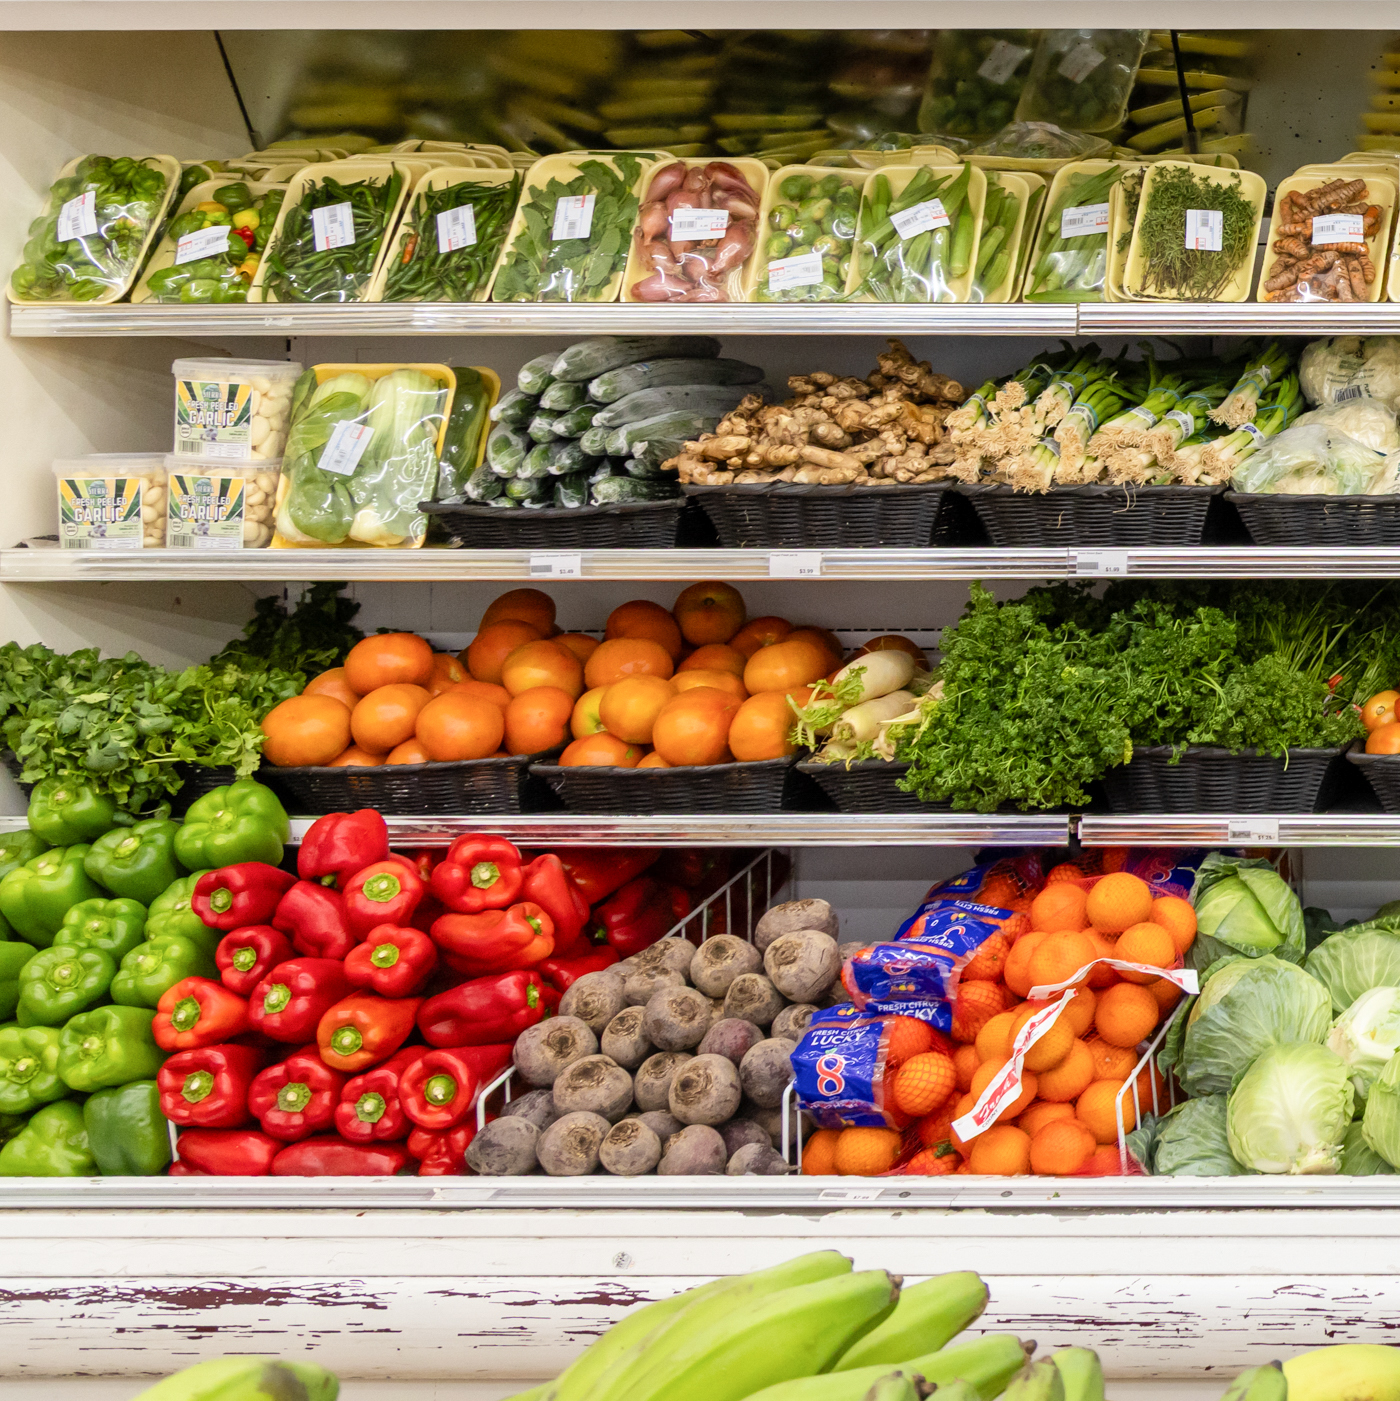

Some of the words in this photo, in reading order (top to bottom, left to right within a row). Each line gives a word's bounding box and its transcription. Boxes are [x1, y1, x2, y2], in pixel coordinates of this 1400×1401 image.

[187, 400, 207, 410] FRESH
[210, 402, 238, 411] PEELED
[189, 411, 235, 426] GARLIC
[74, 507, 125, 522] GARLIC
[180, 505, 227, 520] GARLIC
[842, 1026, 870, 1034] CITRUS
[812, 1030, 866, 1046] LUCKY
[816, 1054, 845, 1096] 8
